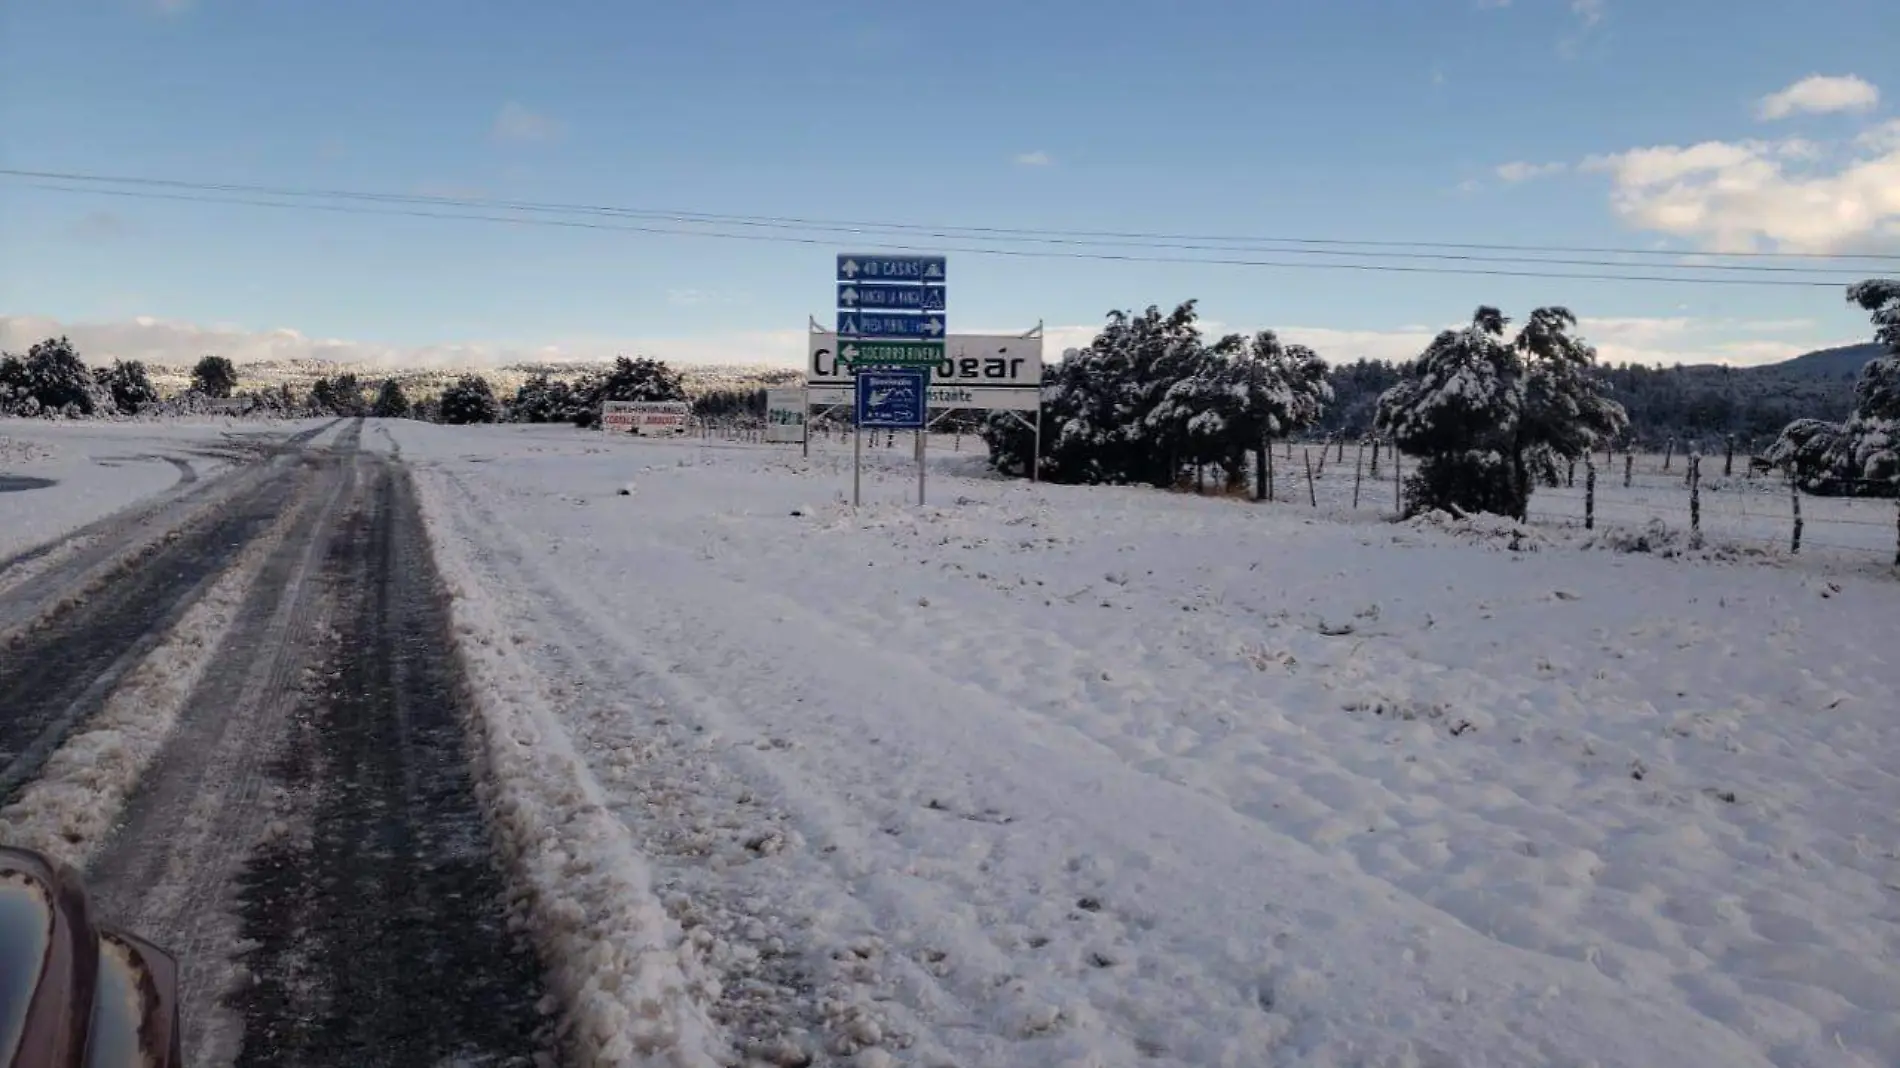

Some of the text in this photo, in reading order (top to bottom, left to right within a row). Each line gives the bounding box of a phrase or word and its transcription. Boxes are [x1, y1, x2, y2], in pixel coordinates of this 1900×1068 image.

[863, 262, 919, 276] 40 CASAS
[861, 347, 941, 361] SOCORRO RIVERA
